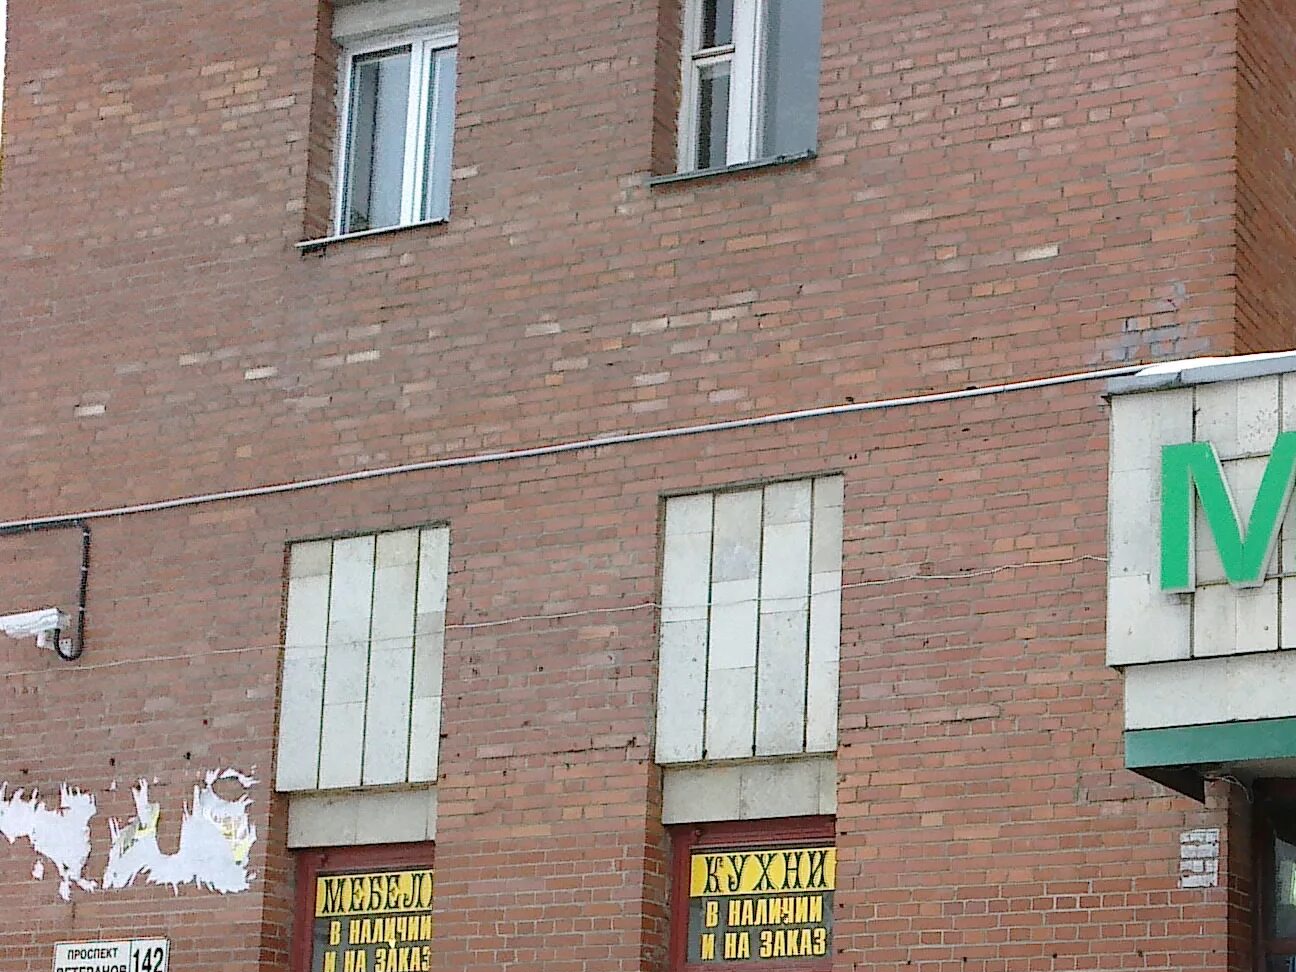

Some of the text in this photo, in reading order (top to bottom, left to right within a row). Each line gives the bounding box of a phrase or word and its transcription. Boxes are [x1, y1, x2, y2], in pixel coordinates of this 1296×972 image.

[704, 850, 827, 893] КУХНИ
[322, 873, 432, 914] МЕБЕЛ
[705, 895, 823, 928] В НАЛИЧИИ
[330, 915, 432, 946] В НАЛИЧИИ
[701, 927, 827, 961] И НА ЗАКАЗ
[67, 947, 119, 961] ПРОСПЕКТ
